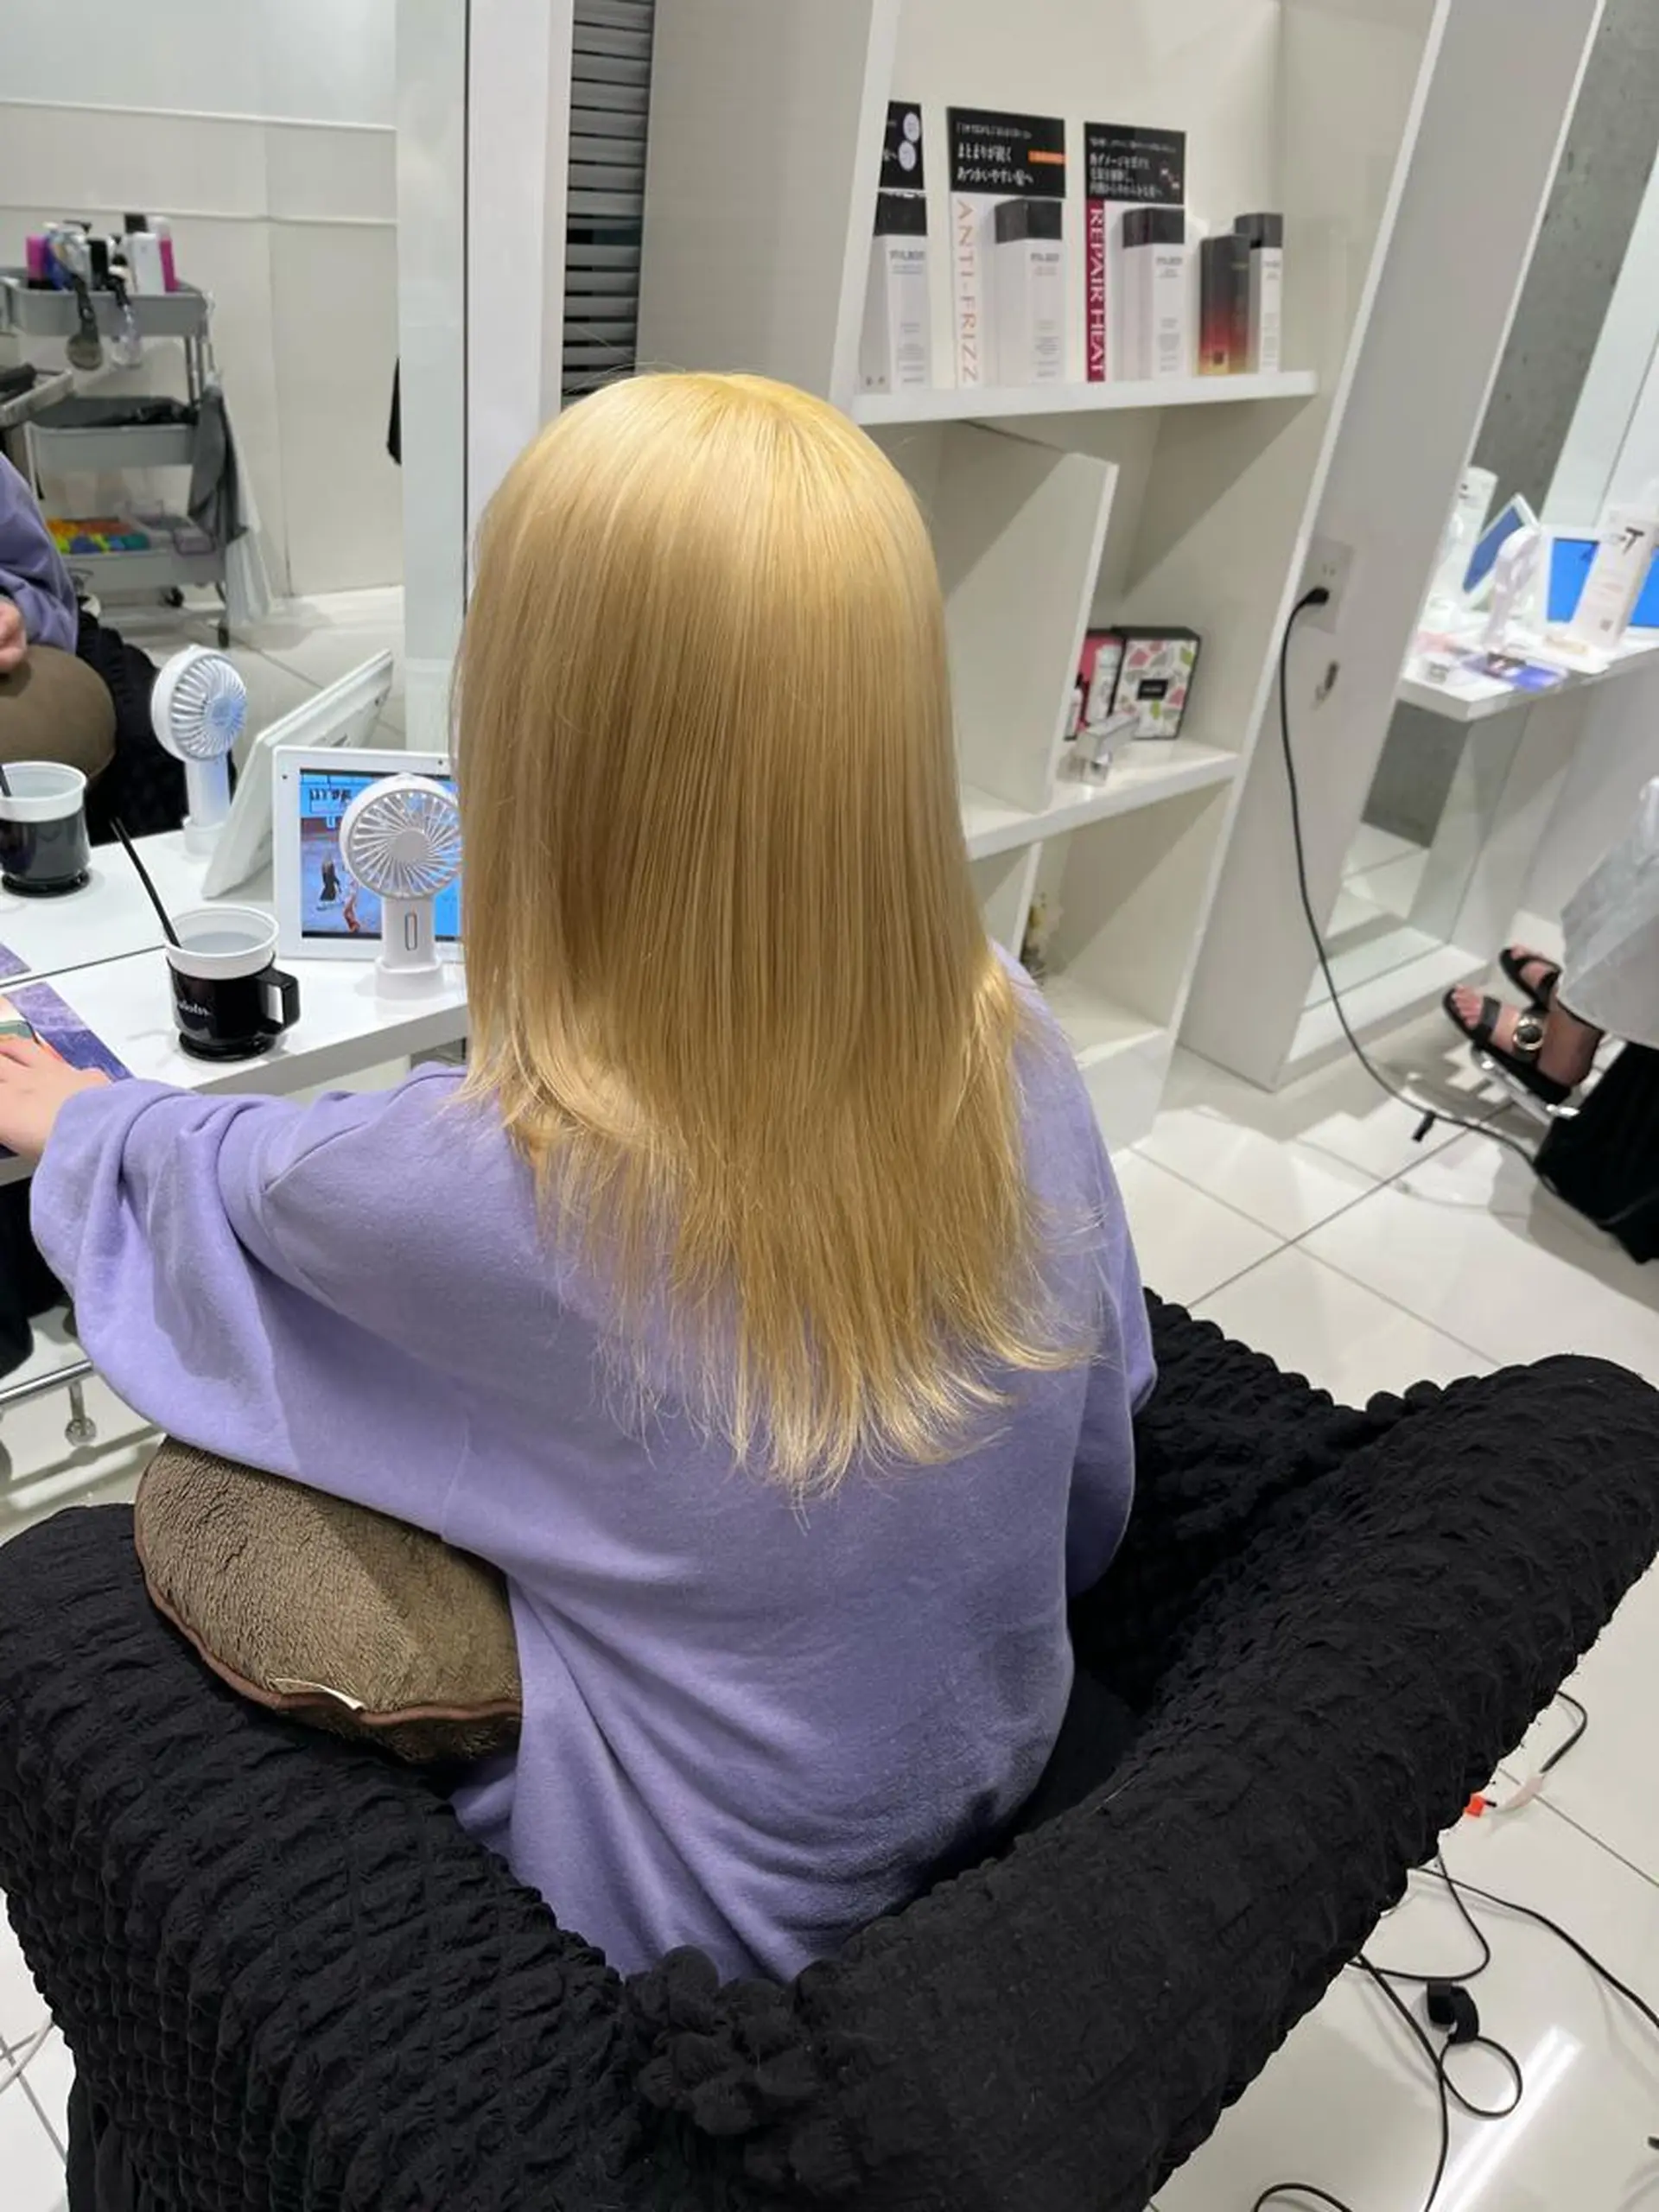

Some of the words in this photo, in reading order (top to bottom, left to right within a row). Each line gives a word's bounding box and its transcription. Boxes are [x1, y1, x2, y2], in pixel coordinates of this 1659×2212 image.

[957, 200, 978, 382] ANTI-FRIZZ
[1090, 207, 1105, 302] REPAIR
[1090, 308, 1105, 372] HEAT
